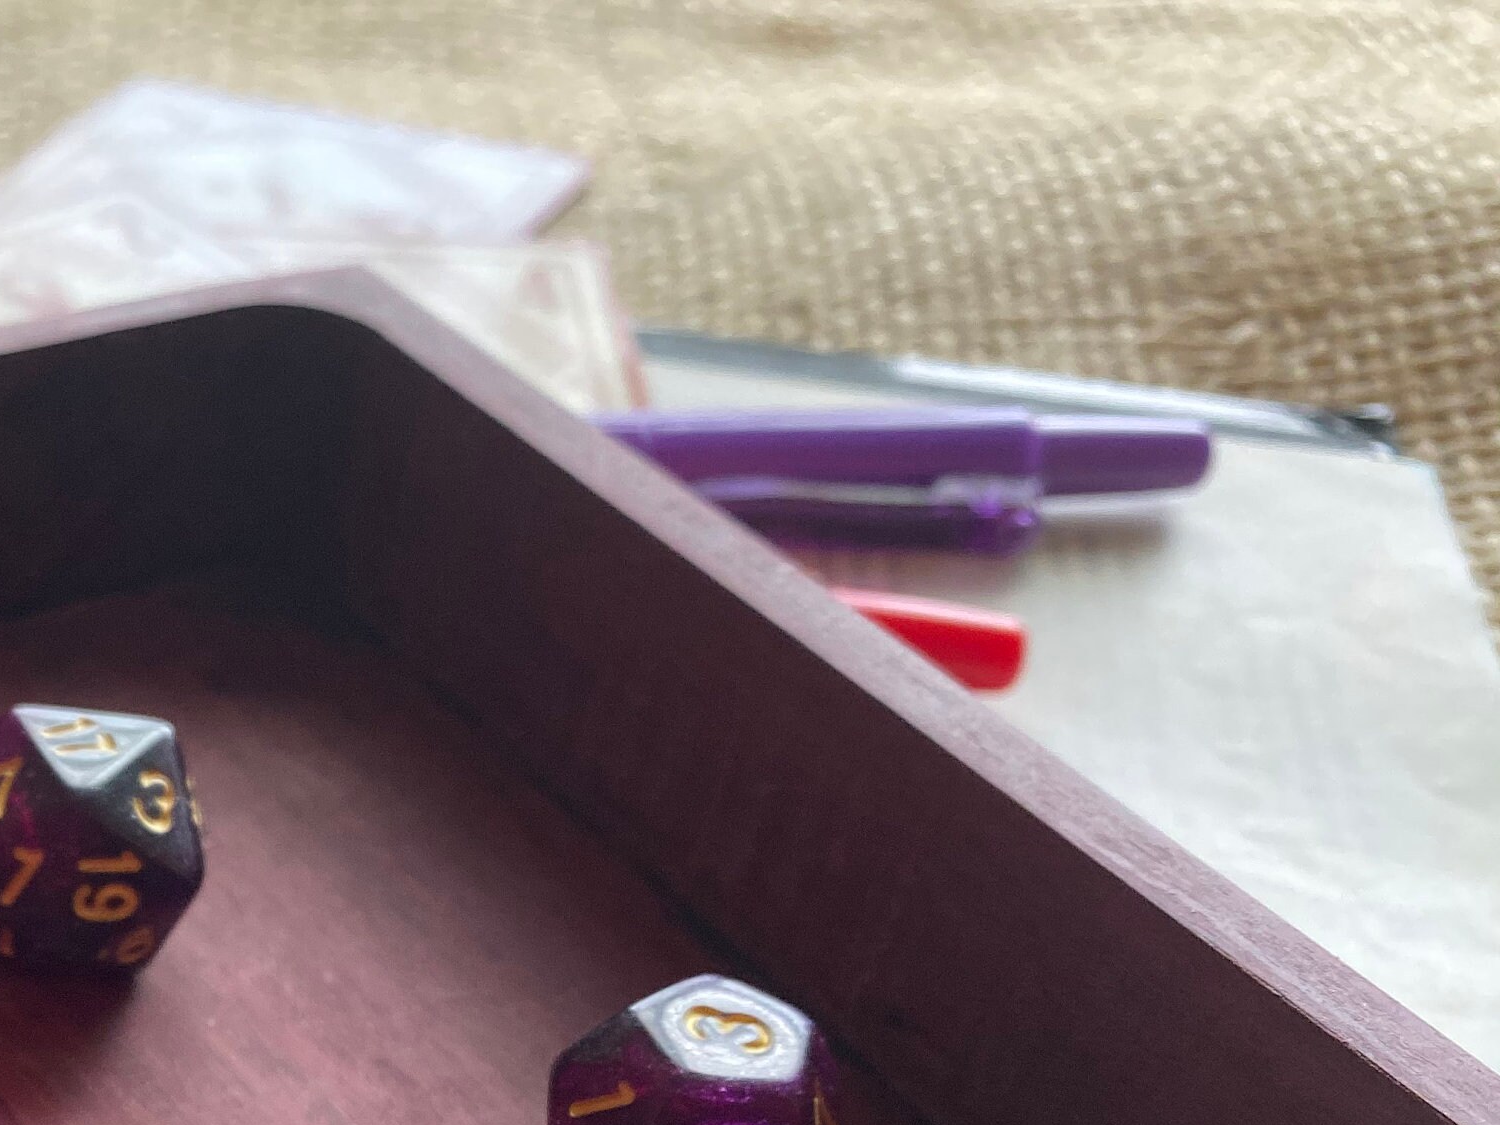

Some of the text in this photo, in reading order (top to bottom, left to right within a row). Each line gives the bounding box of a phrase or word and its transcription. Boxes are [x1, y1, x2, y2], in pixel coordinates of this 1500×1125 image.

[133, 770, 176, 834] 3
[682, 1005, 773, 1057] 3
[568, 1080, 637, 1119] 1
